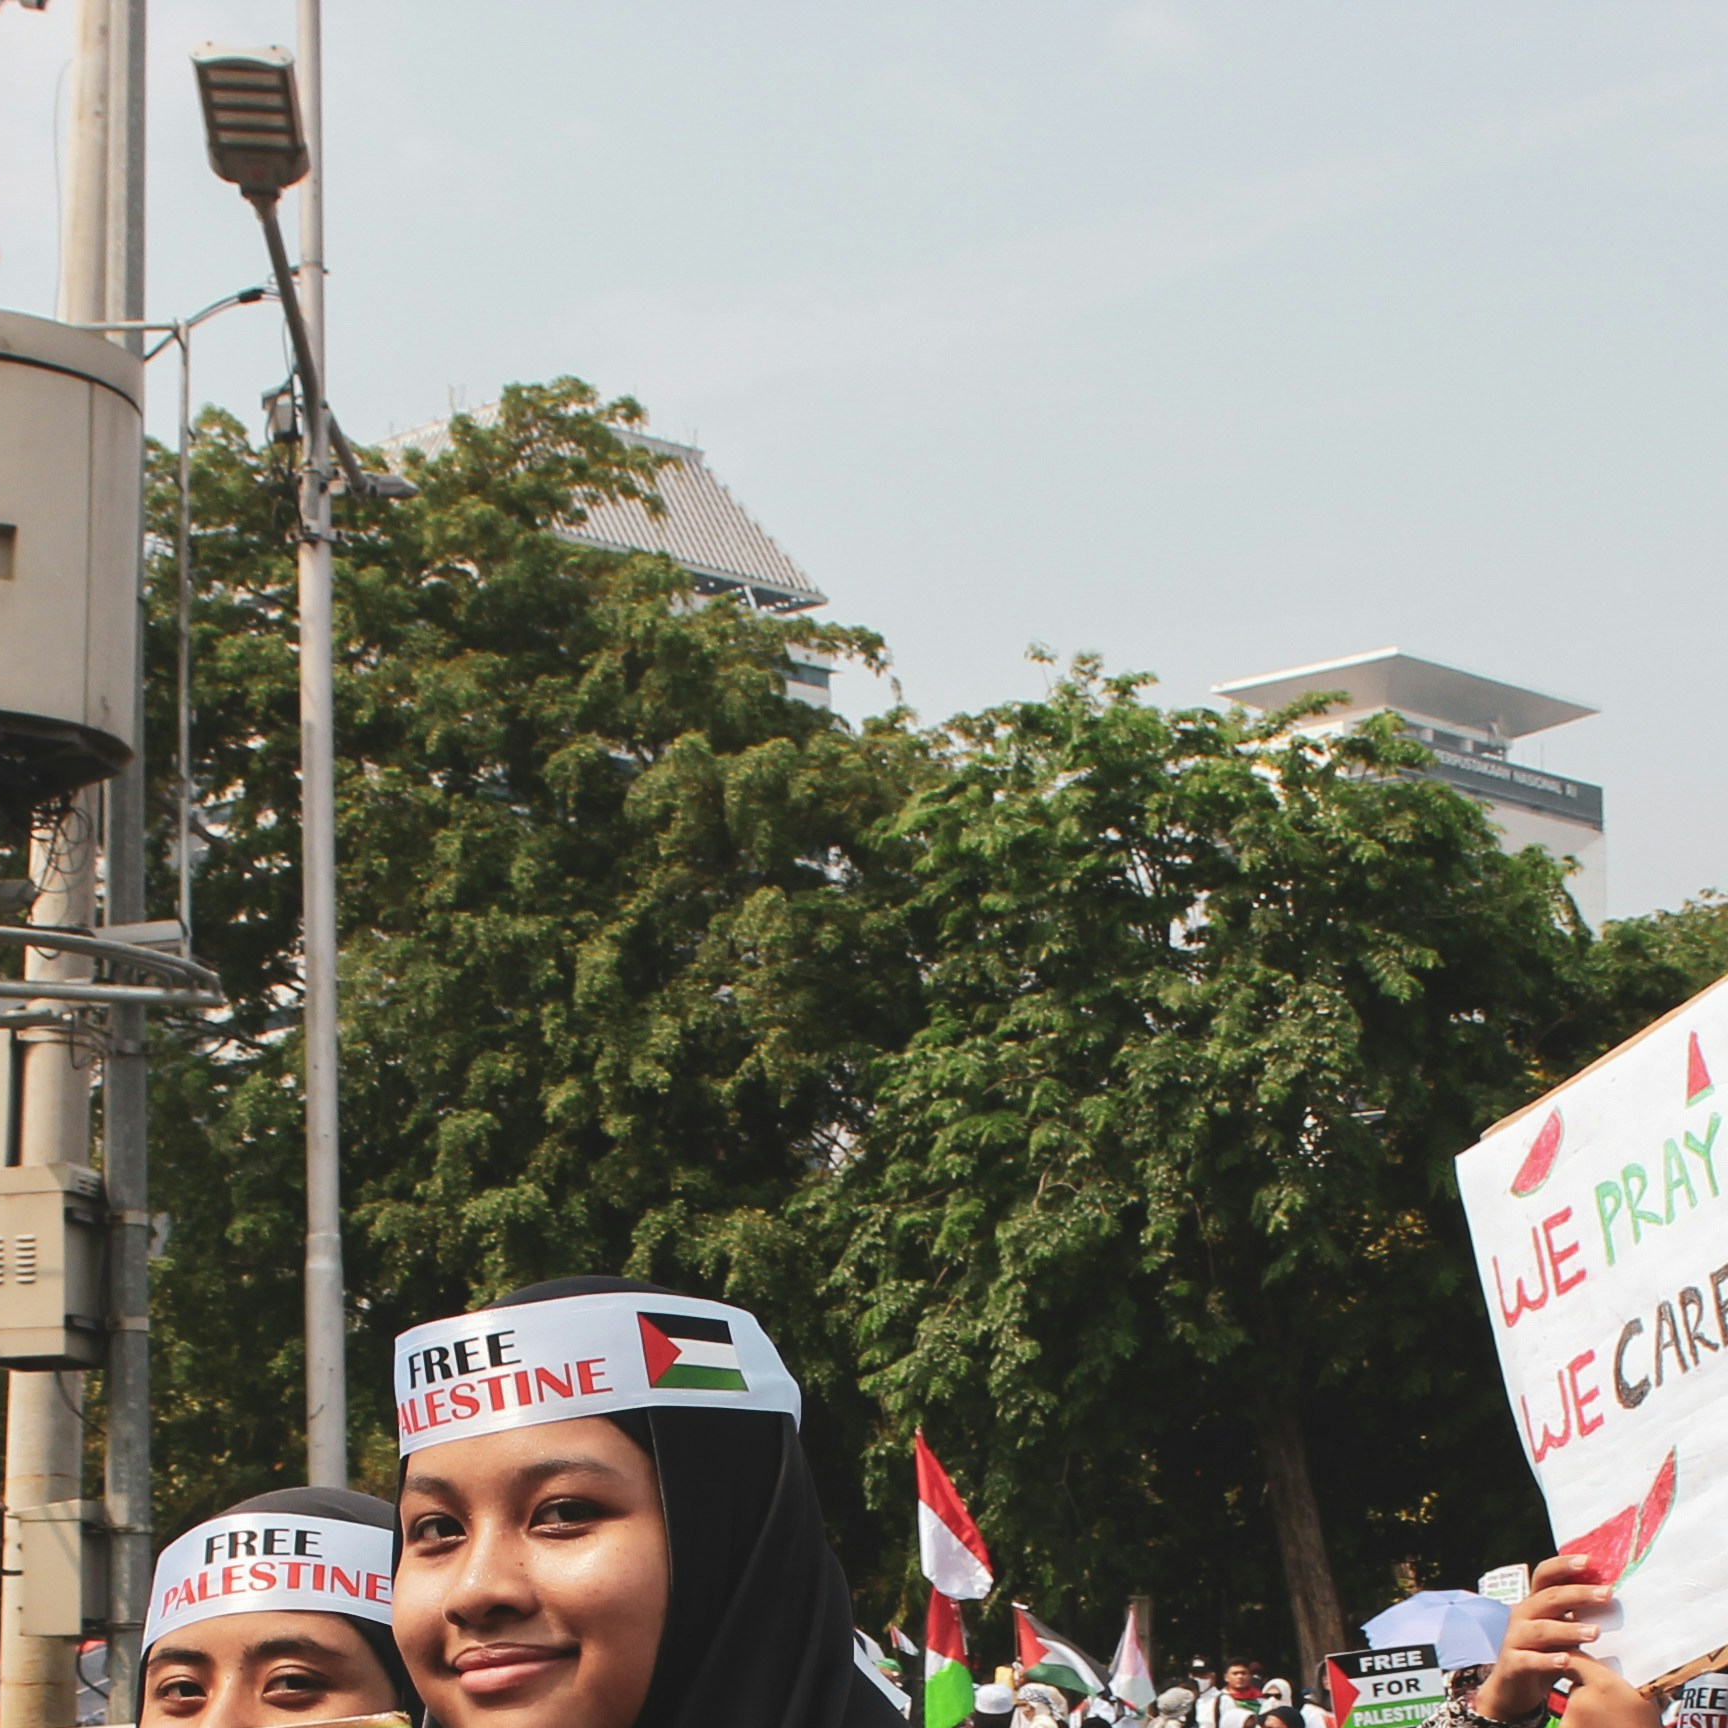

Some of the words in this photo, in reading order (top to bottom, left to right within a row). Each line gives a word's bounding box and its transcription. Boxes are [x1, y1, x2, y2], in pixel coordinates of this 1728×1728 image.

[1491, 1205, 1588, 1328] WE
[1594, 1112, 1722, 1267] PRAY
[409, 1330, 521, 1390] FREE
[1520, 1350, 1604, 1464] WE
[205, 1528, 322, 1564] FREE
[161, 1560, 392, 1618] PALESTINE
[1359, 1650, 1423, 1672] FREE
[1372, 1678, 1421, 1697] FOR
